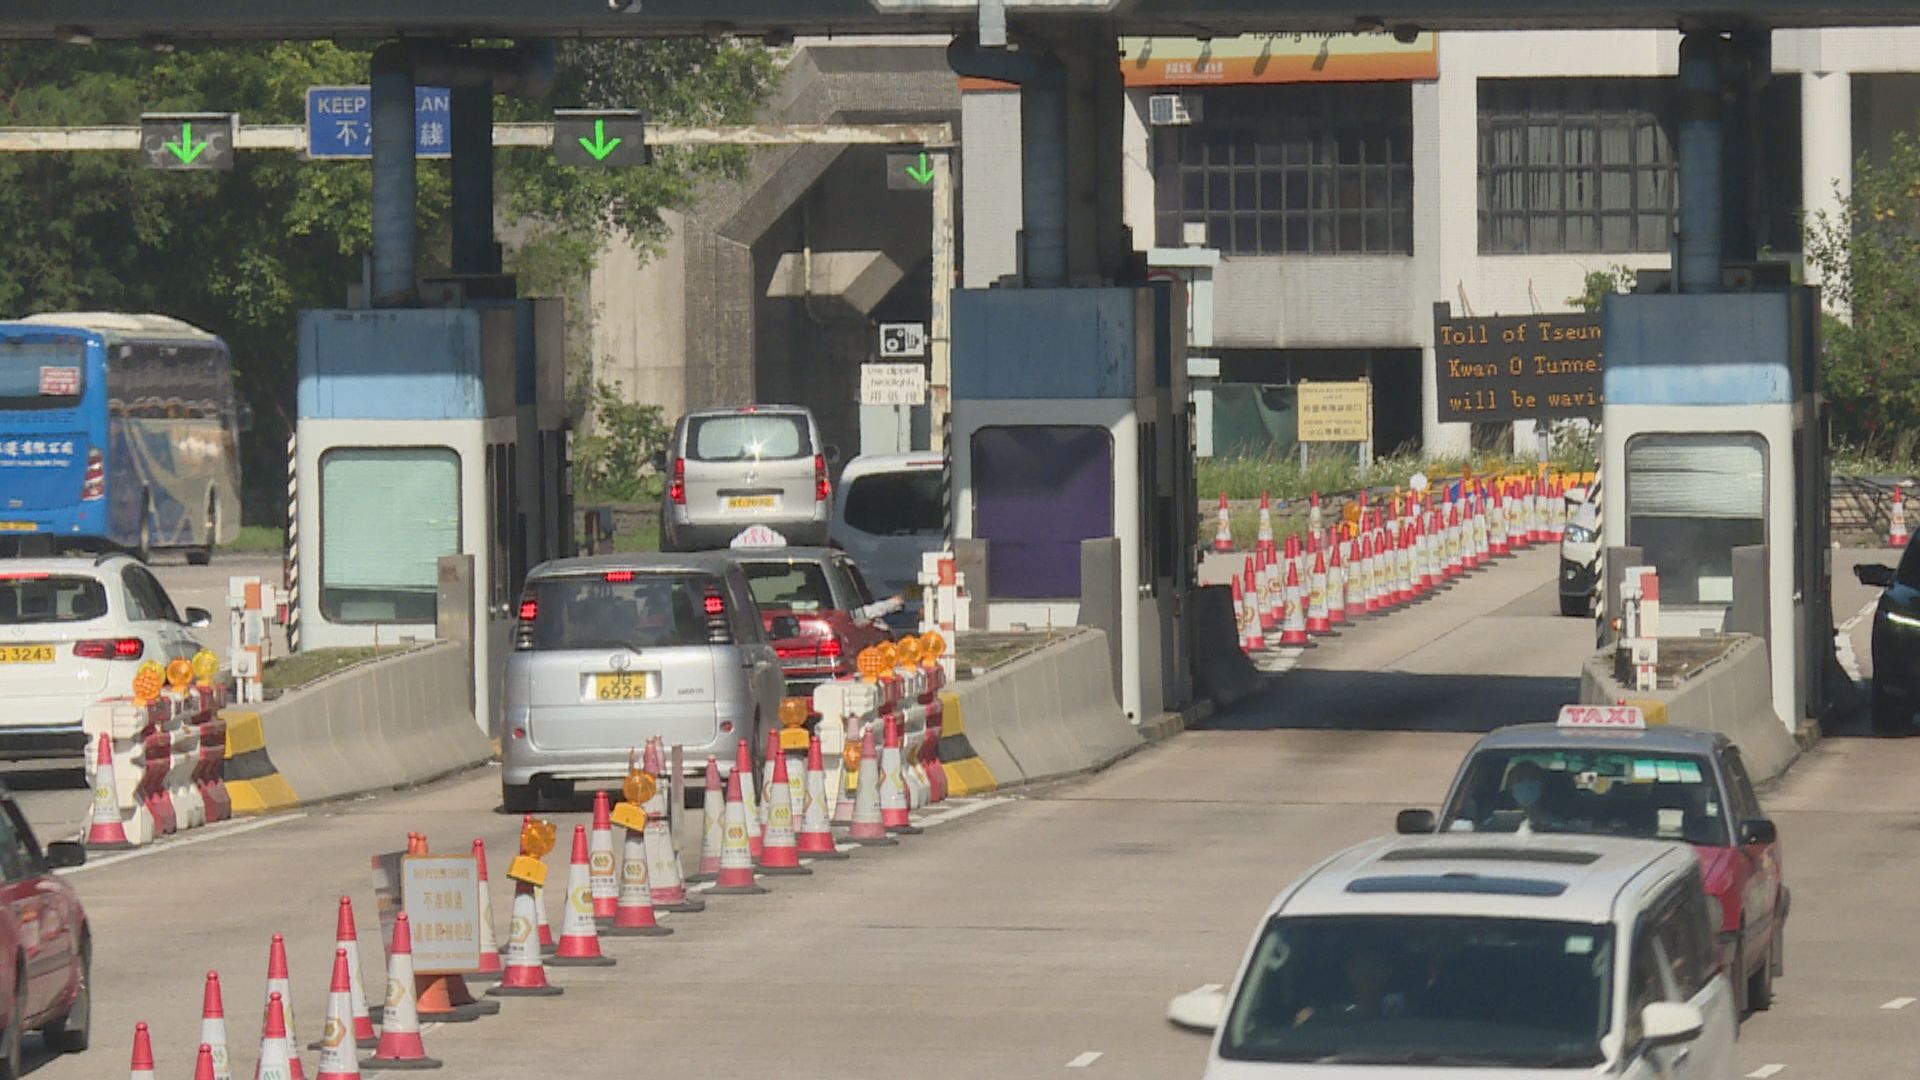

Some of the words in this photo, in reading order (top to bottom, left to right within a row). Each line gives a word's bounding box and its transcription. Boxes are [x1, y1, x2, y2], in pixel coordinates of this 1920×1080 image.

[317, 96, 367, 113] KEEP
[415, 96, 449, 113] AN
[1440, 325, 1488, 345] Toll
[1502, 322, 1527, 344] of
[1537, 321, 1602, 342] Tseun
[1448, 358, 1498, 379] Kwan
[1449, 390, 1497, 411] will
[1511, 389, 1536, 408] be
[11, 647, 53, 661] 3243
[611, 669, 632, 686] JG
[600, 685, 643, 700] 6925
[1567, 707, 1637, 724] TAXI
